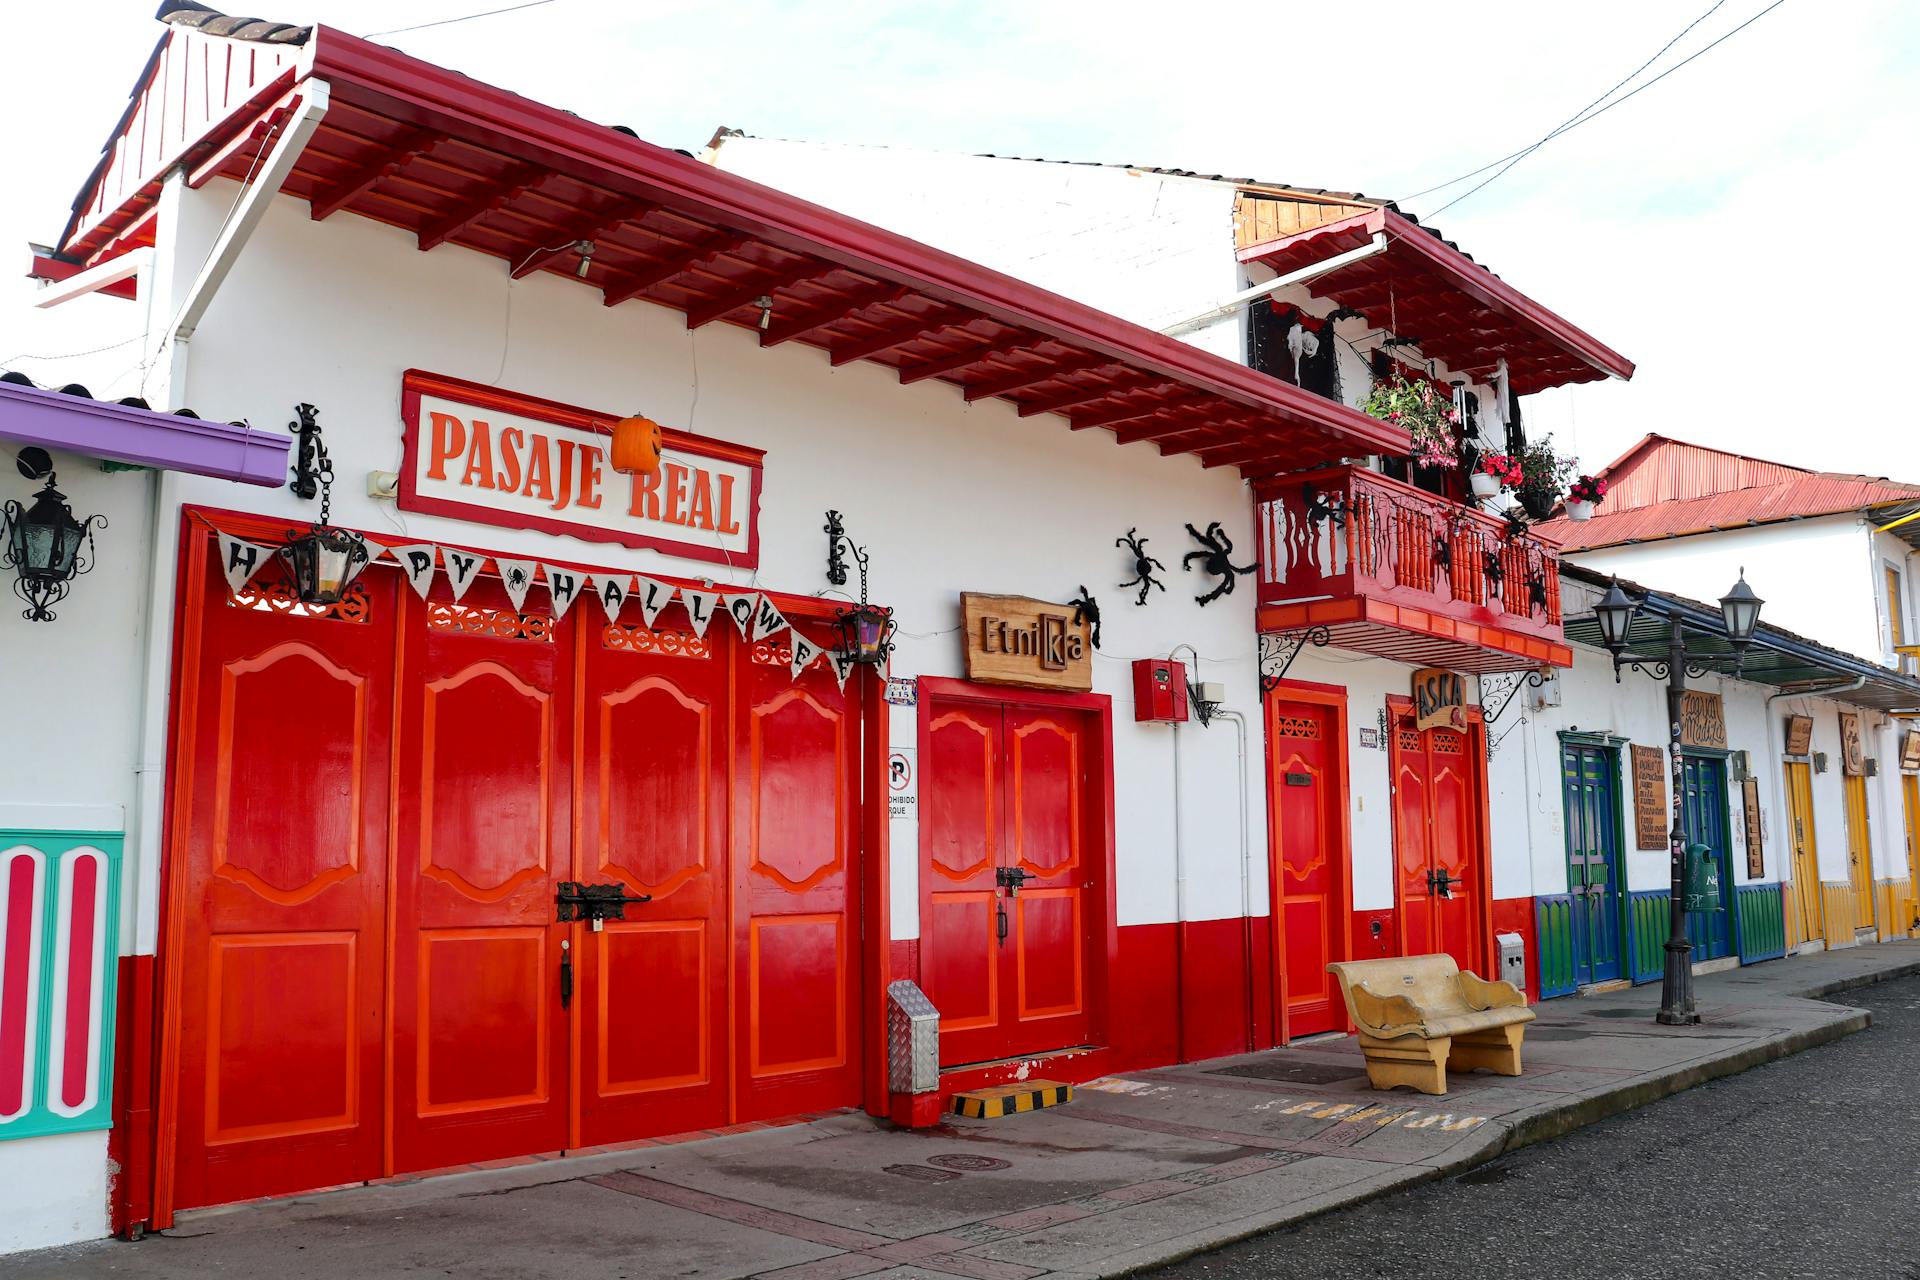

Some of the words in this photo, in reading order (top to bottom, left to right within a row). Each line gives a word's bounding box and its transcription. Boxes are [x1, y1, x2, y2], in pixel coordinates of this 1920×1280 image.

[427, 411, 603, 510] PASAJE
[628, 462, 740, 535] REAL
[229, 542, 475, 584] HPY
[889, 796, 915, 804] OHIBIDO
